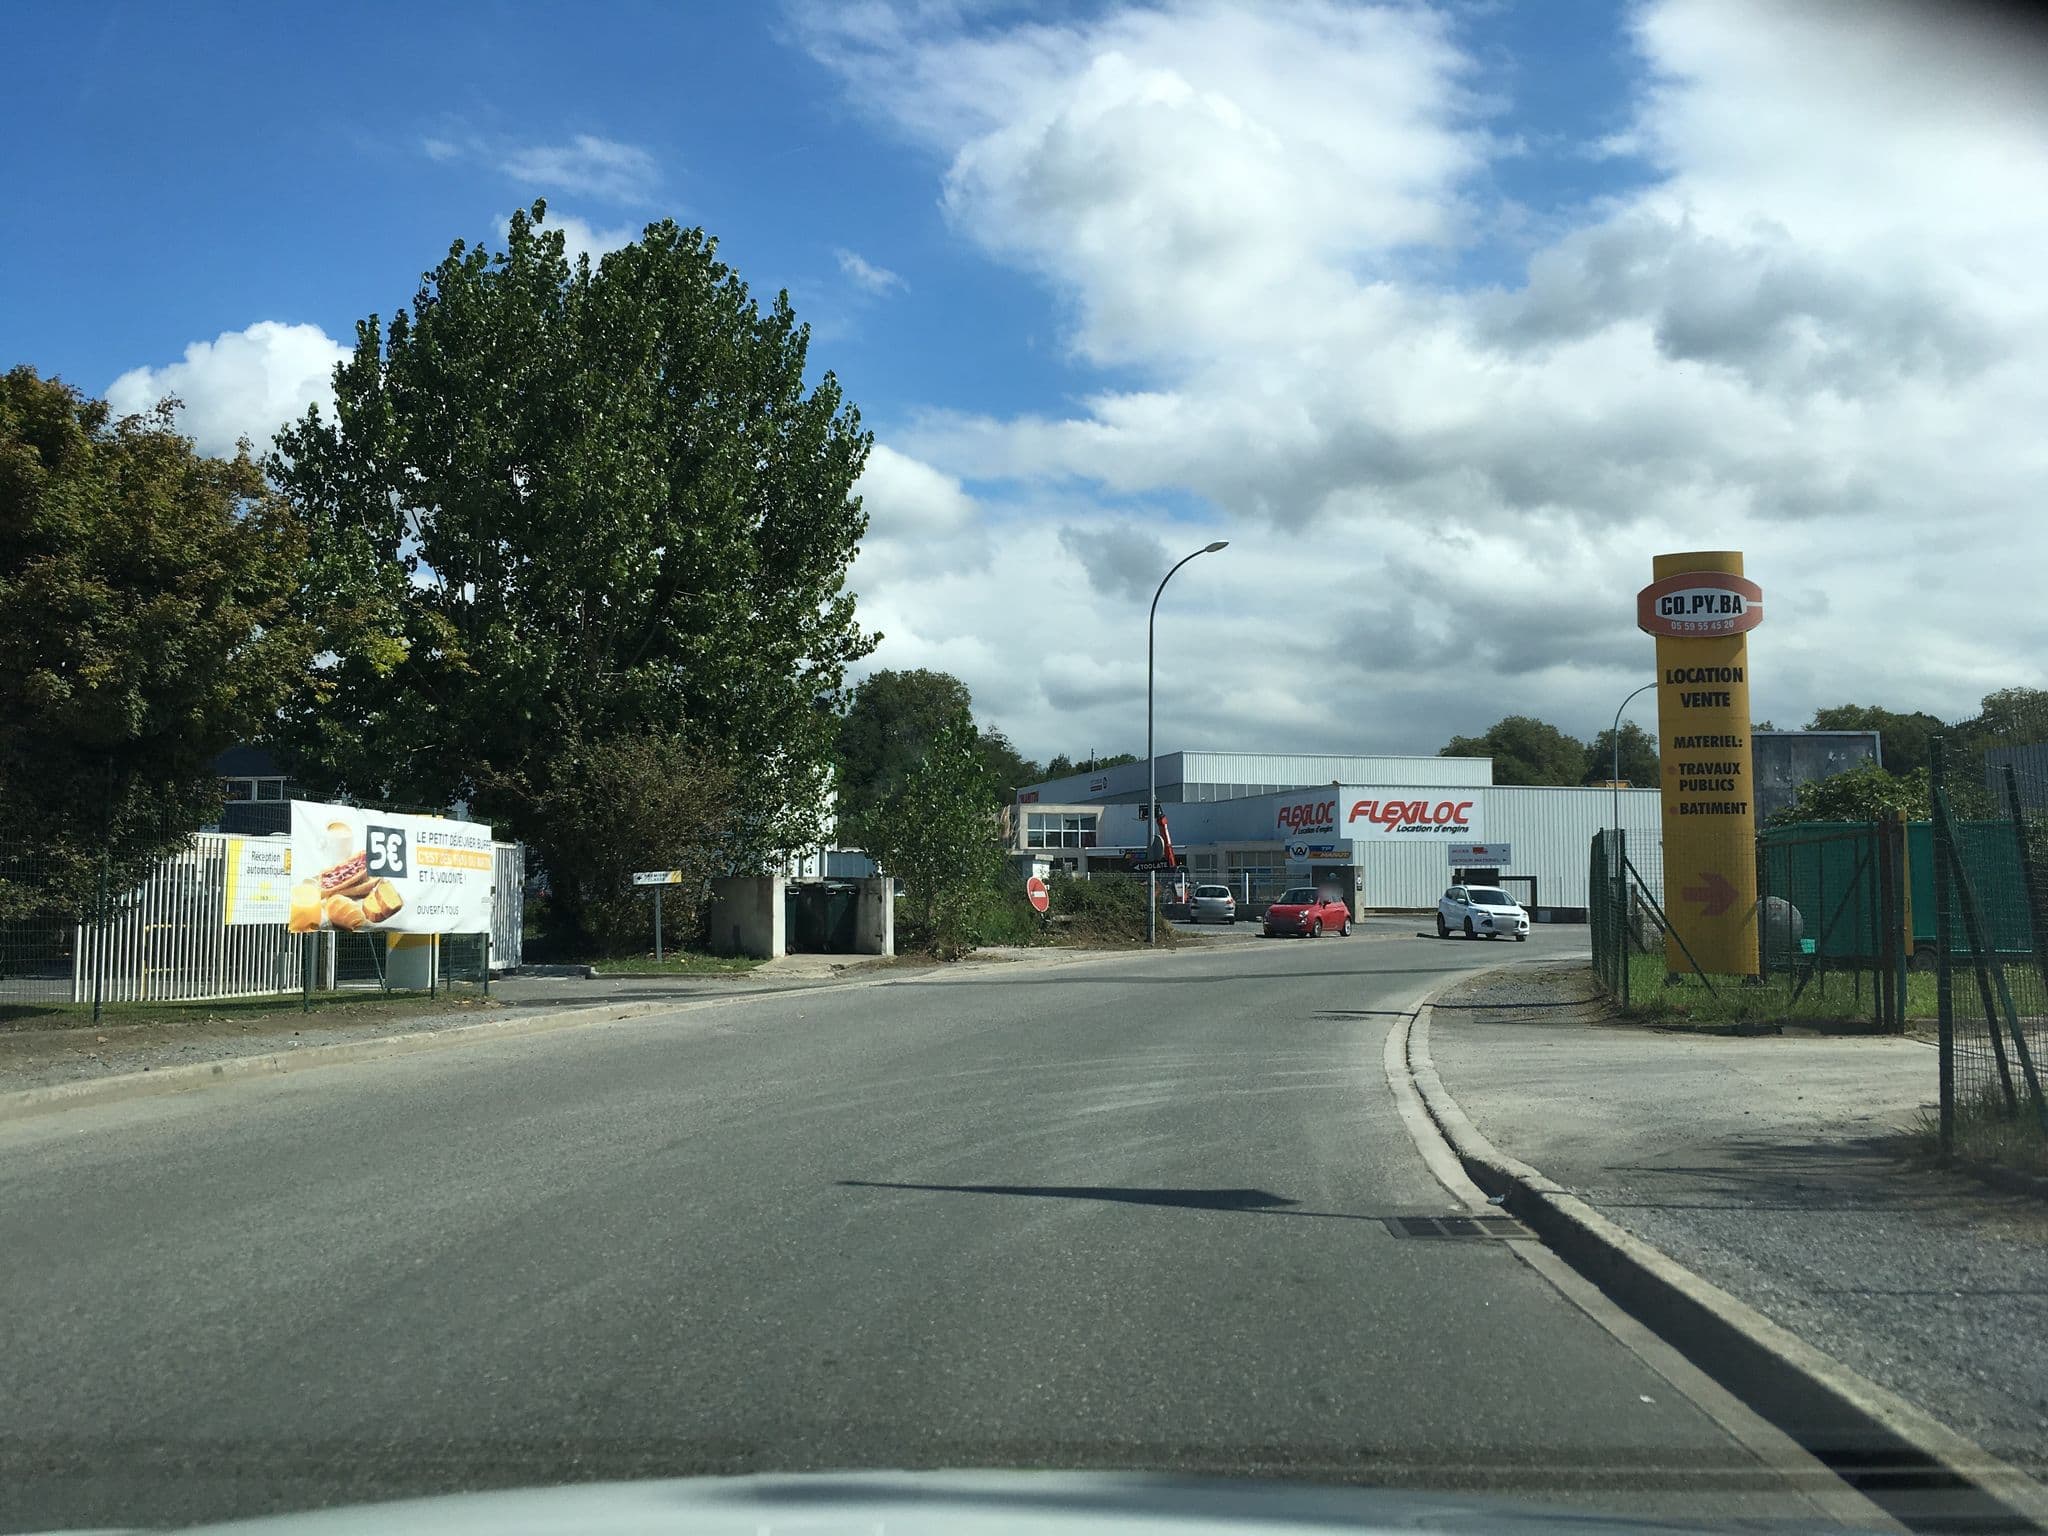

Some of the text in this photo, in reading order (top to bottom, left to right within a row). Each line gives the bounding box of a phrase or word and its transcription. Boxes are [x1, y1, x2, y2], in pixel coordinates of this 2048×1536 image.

[1661, 594, 1743, 616] CO.PY.BA
[1665, 667, 1743, 685] LOCATION
[1680, 692, 1731, 708] VENTE
[1673, 736, 1743, 749] MATERIEL:
[1678, 762, 1741, 775] TRAVAUX
[1679, 779, 1735, 792] PUBLICS
[1679, 802, 1747, 815] BATIMENT
[1396, 825, 1432, 833] Location
[416, 832, 426, 844] LE
[429, 832, 448, 845] PETIT
[369, 831, 403, 872] 5€
[419, 870, 428, 882] ET
